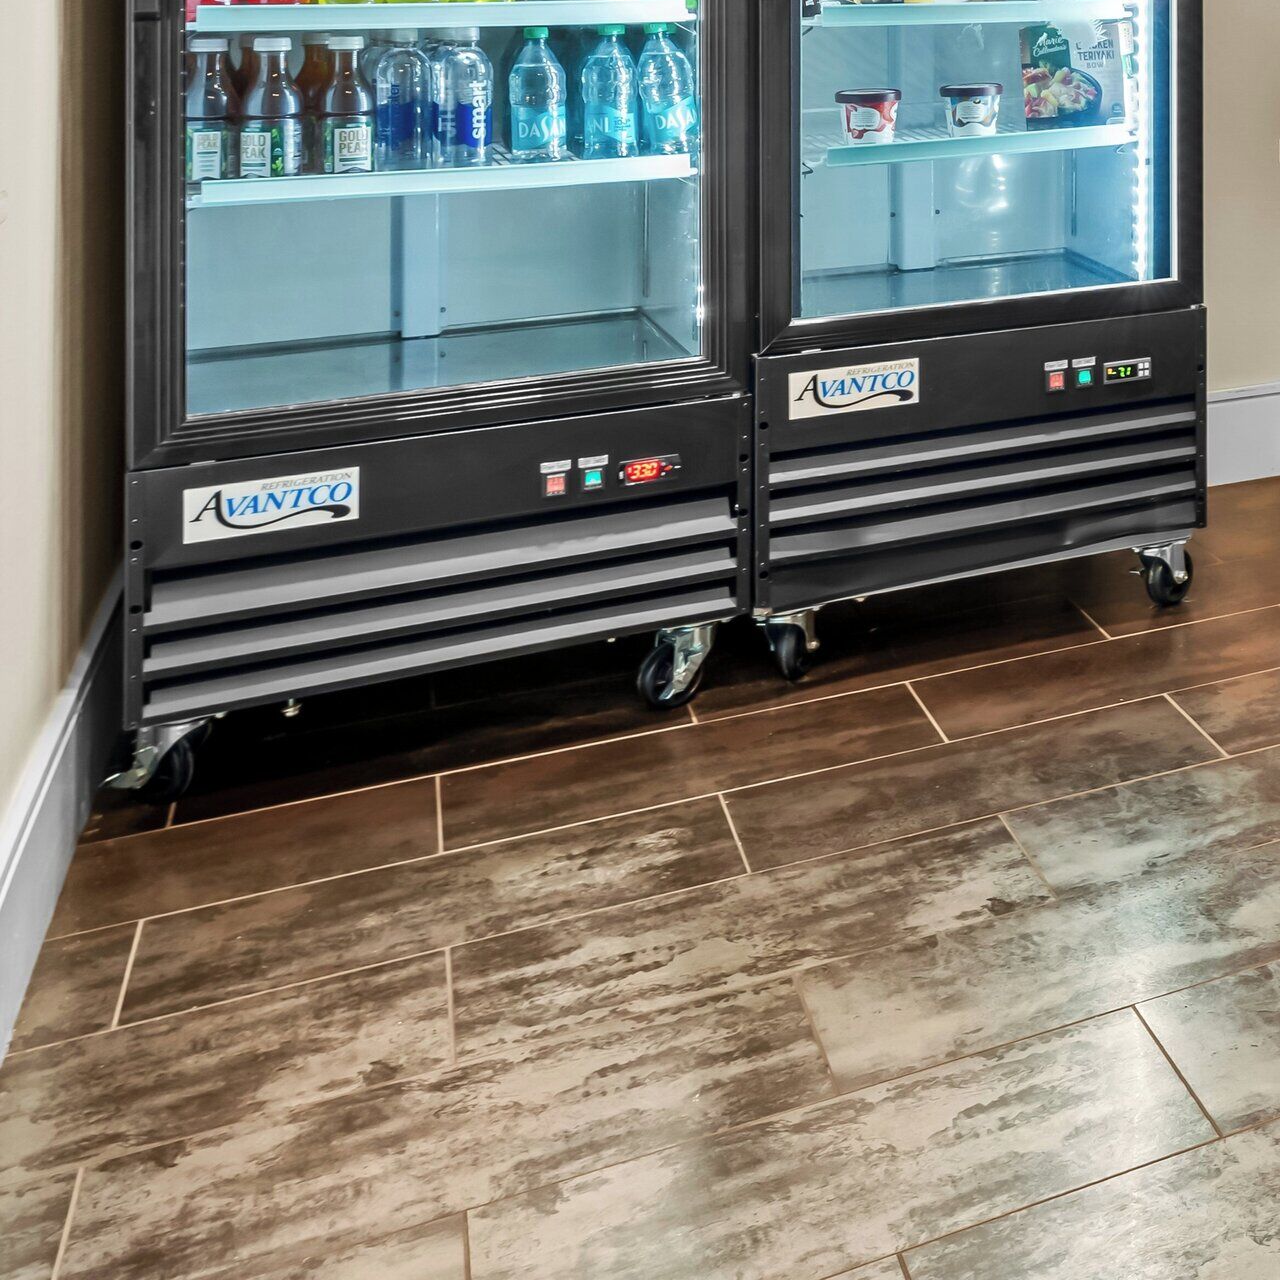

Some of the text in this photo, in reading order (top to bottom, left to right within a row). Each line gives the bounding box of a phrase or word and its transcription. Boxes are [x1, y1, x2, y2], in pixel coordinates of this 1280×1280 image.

[1078, 50, 1115, 61] TERIYAKI
[471, 79, 488, 140] smart
[338, 129, 369, 143] GOLD
[518, 116, 566, 142] DASAN
[793, 369, 916, 409] AVANTCO
[260, 471, 353, 491] REFRIGERATION
[189, 481, 353, 530] AVANTCO
